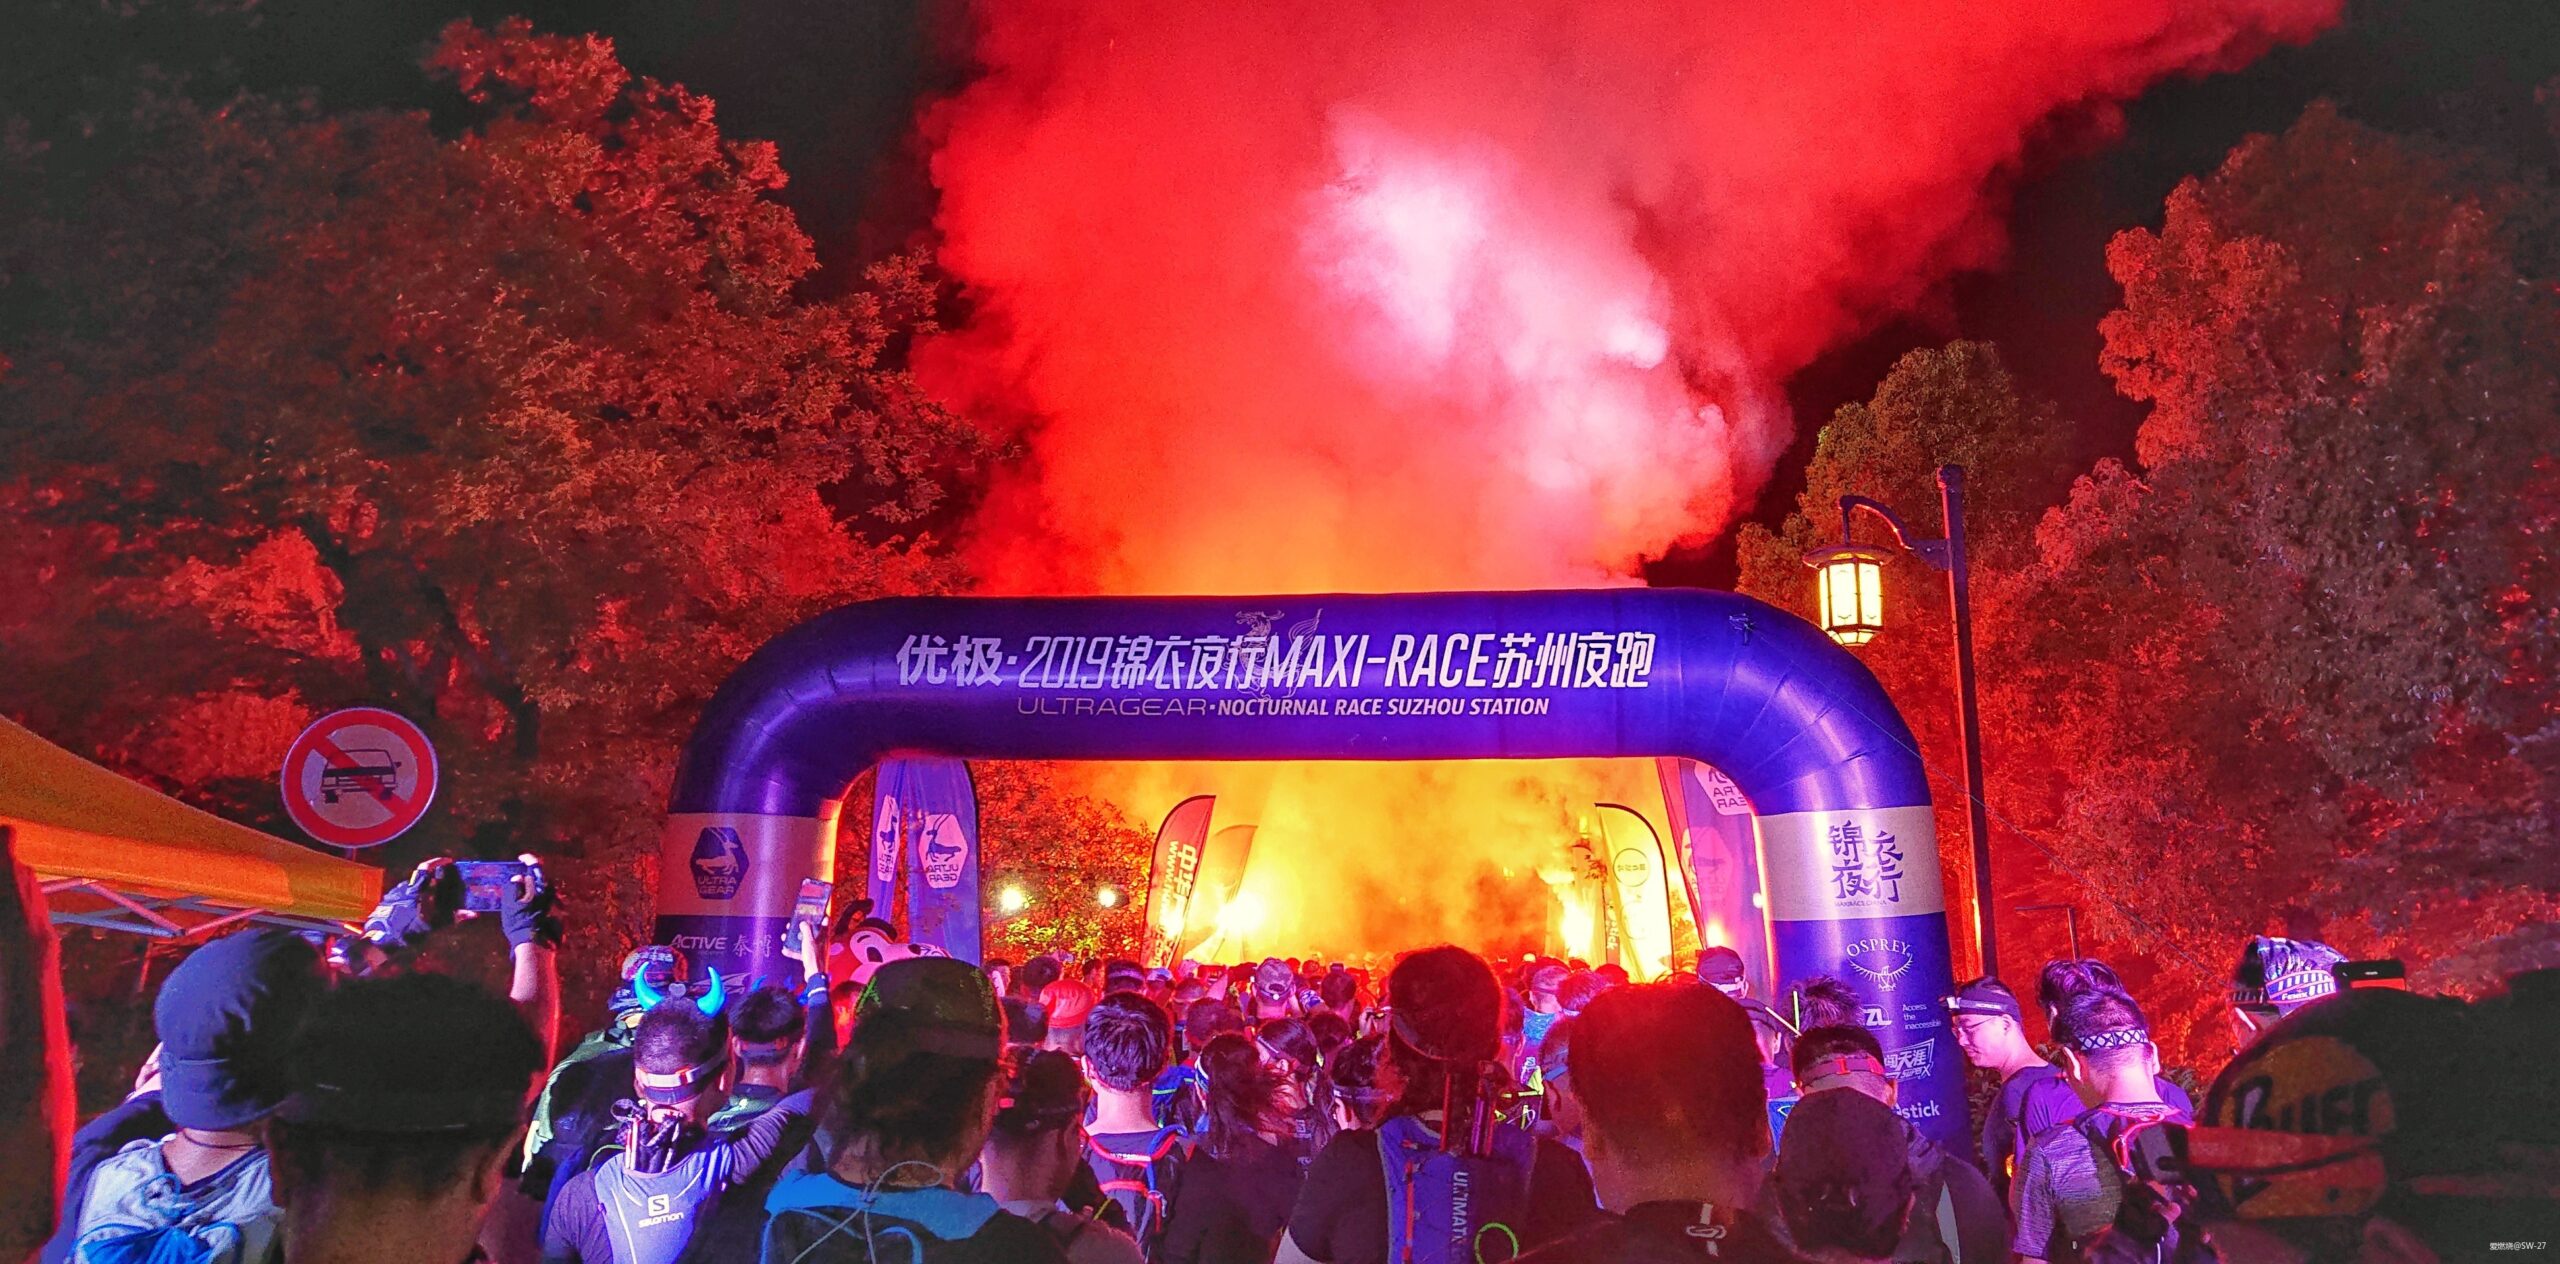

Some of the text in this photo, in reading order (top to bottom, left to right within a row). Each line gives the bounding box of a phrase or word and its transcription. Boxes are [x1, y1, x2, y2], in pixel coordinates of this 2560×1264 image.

[1334, 697, 1383, 716] RACE
[1386, 697, 1466, 716] SUZHOU
[1469, 697, 1549, 716] STATION
[697, 876, 737, 885] ULTRA
[700, 886, 736, 895] GEAR
[671, 934, 728, 950] ACTIVE
[1846, 938, 1912, 957] OSPREY
